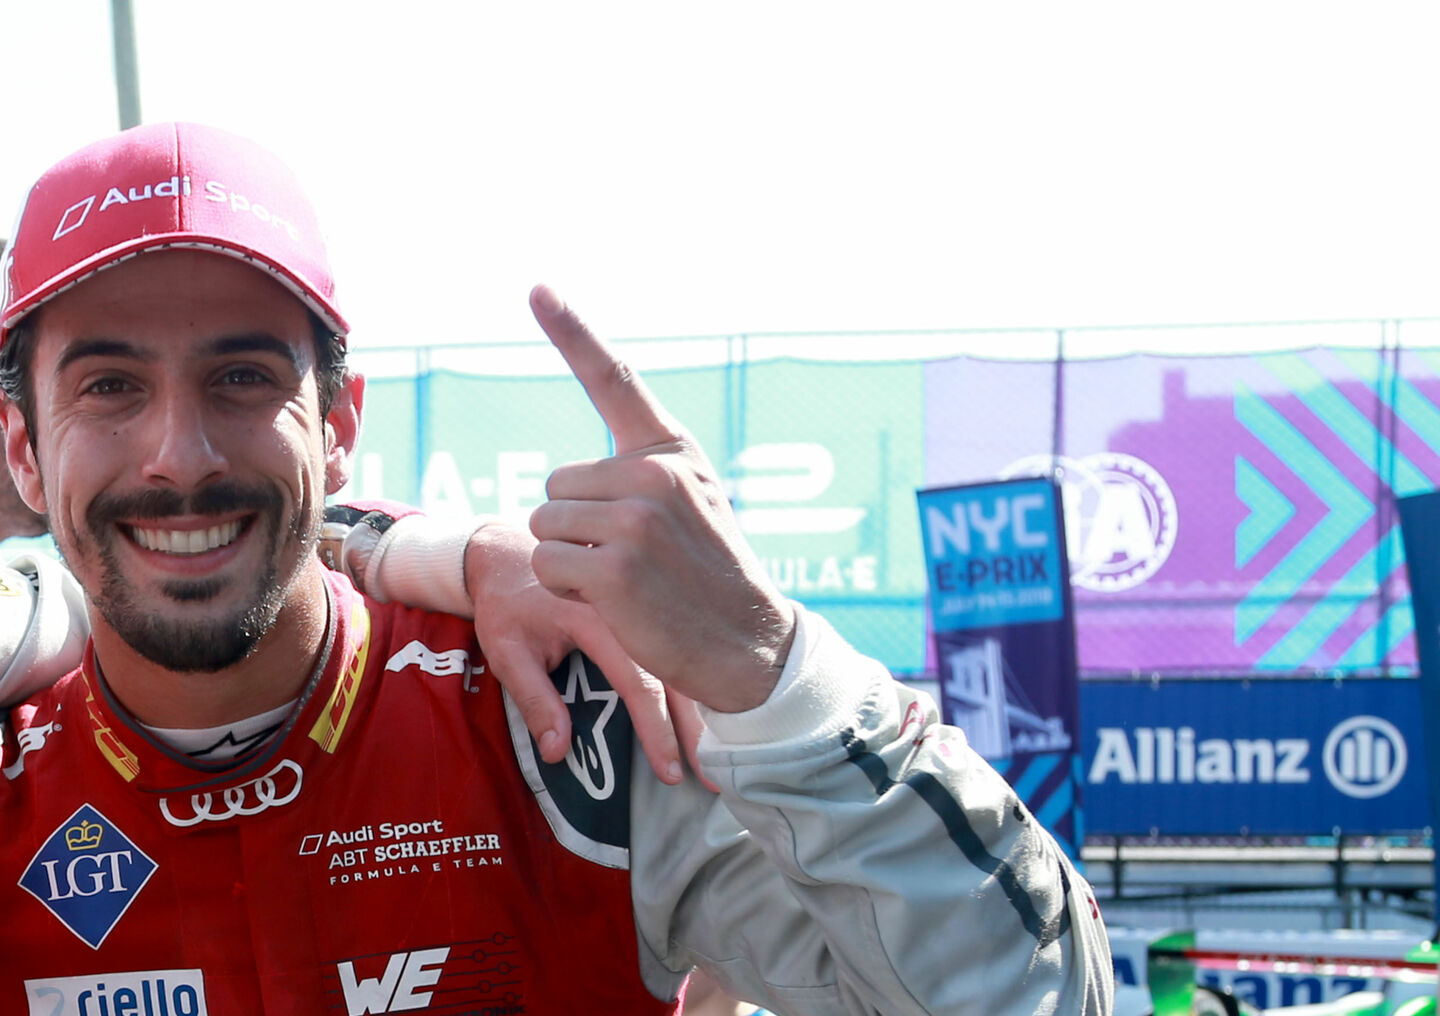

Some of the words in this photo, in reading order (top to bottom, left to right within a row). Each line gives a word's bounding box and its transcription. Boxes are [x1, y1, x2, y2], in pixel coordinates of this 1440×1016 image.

[99, 176, 192, 212] Audi
[205, 180, 299, 241] Sport
[926, 494, 1047, 558] NYC
[936, 552, 1048, 592] E-PRIX
[1088, 727, 1311, 784] Allianz
[326, 826, 374, 847] Audi
[379, 819, 443, 840] Sport
[328, 848, 369, 870] ABT
[374, 834, 501, 862] SCHAEFFLER
[41, 850, 133, 901] LGT
[329, 864, 420, 885] FORMULA
[433, 863, 441, 872] E
[453, 857, 503, 869] TEAM
